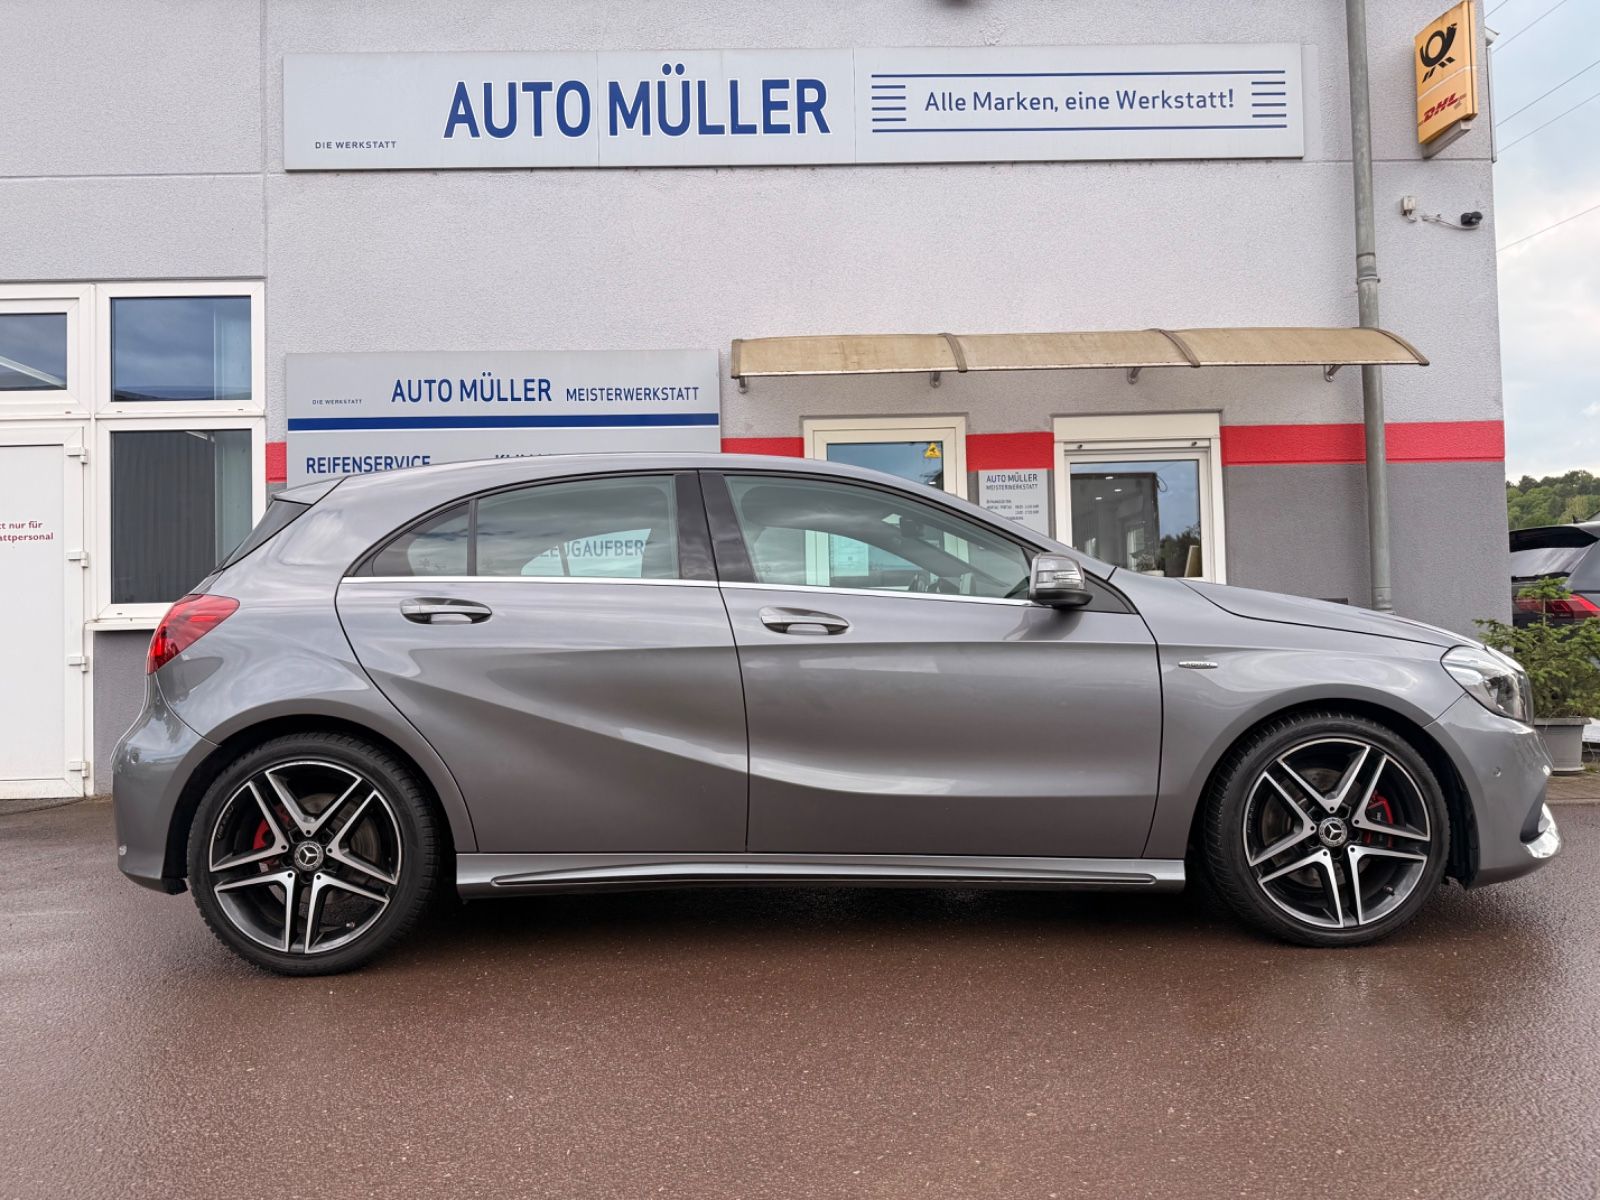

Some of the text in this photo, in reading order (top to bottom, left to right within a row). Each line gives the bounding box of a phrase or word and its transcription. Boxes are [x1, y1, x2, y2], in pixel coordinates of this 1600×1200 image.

[443, 62, 832, 140] AUTO MÜLLER
[924, 88, 1235, 113] Alle Marken, eine Werkstatt!
[1423, 92, 1458, 123] DHL
[314, 140, 398, 150] DIE WERKSTATT
[391, 371, 553, 404] AUTO MÜLLER
[566, 385, 701, 402] MEISTERWERKSTATT
[306, 455, 431, 474] REIFENSERVICE
[986, 471, 1038, 483] AUTO MÜLLER
[986, 483, 1038, 491] MEISTERWERKSTATT
[9, 522, 26, 530] nur
[28, 520, 43, 529] für
